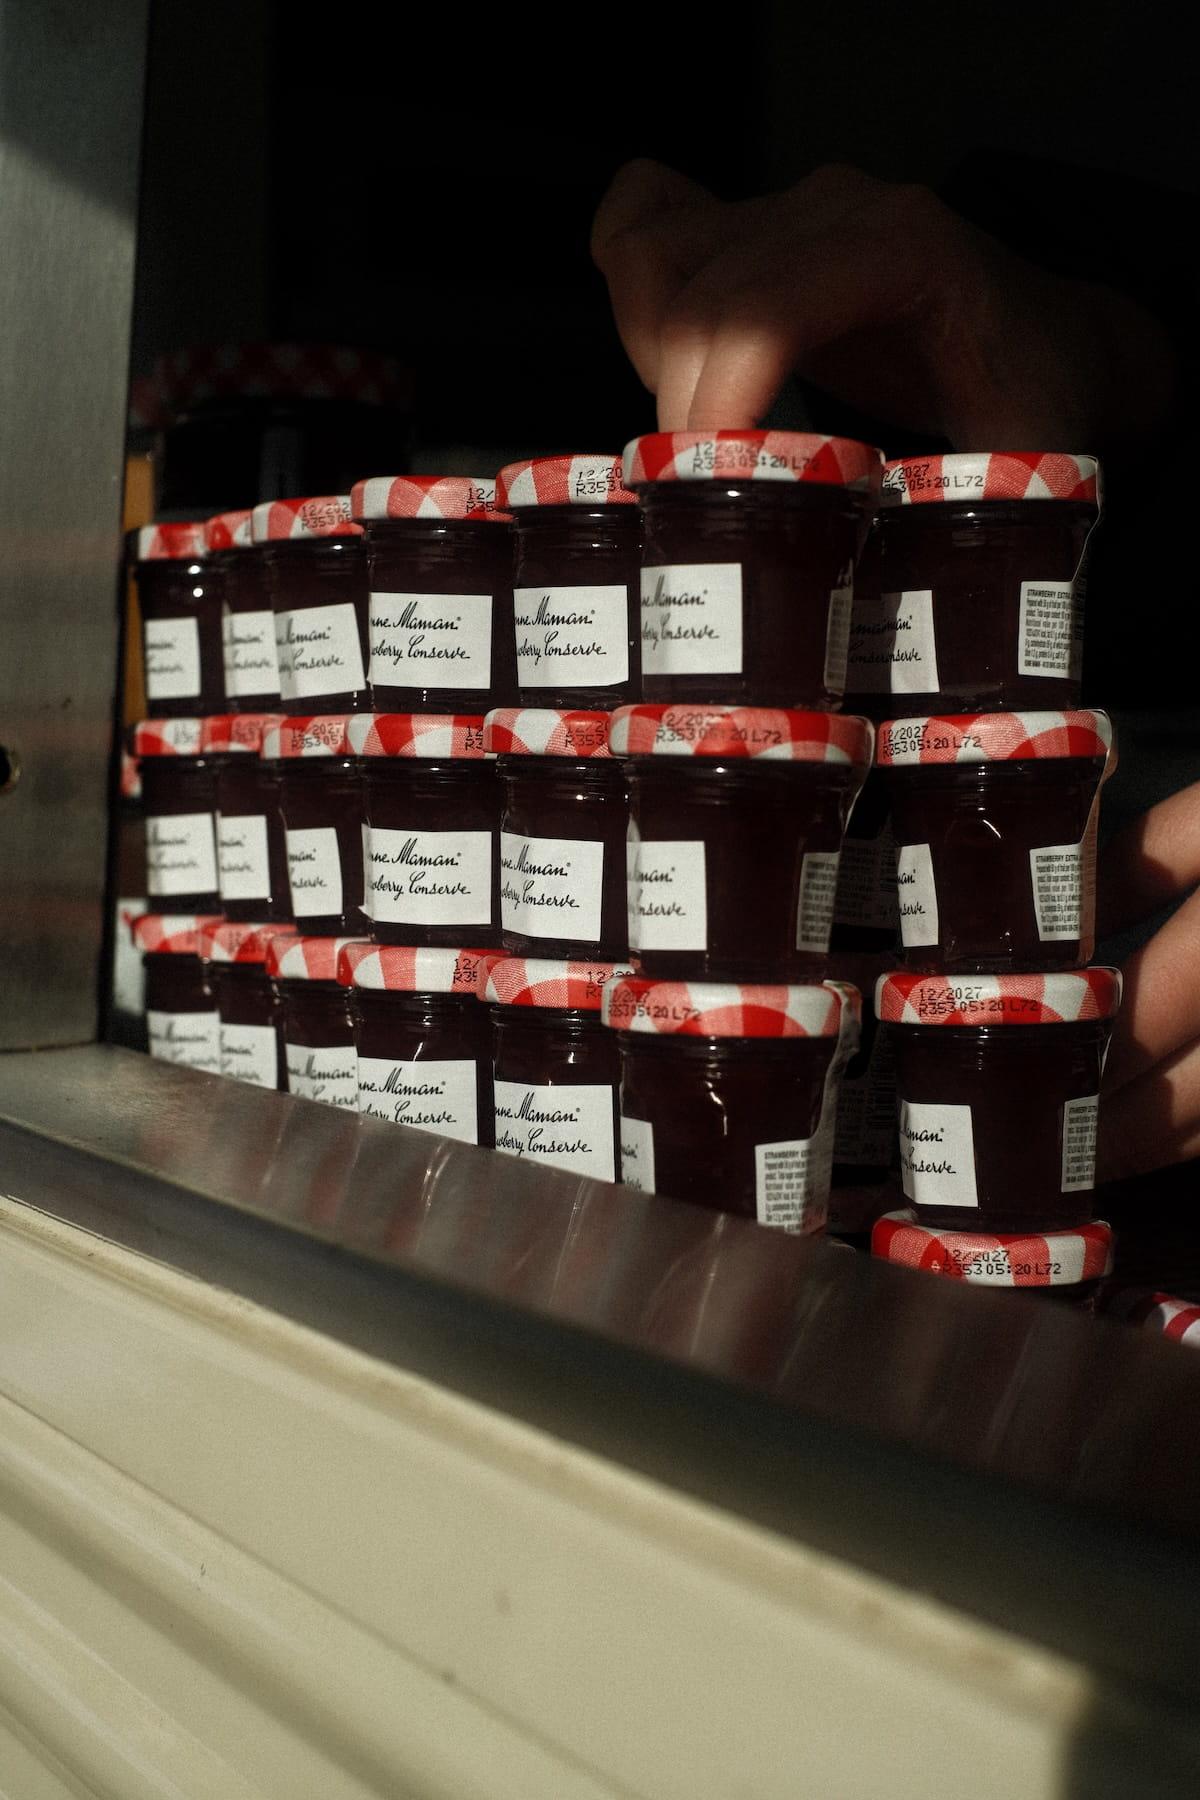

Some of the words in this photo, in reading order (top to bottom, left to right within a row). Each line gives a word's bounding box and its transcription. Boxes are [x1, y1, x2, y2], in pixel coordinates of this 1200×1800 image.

[955, 475, 984, 488] L72
[407, 633, 471, 660] Conserve
[544, 630, 607, 656] Conserve
[954, 736, 982, 749] L72
[409, 871, 471, 895] Conserve
[523, 880, 580, 908] Conserve
[918, 986, 983, 1002] 12/2027
[1009, 1000, 1039, 1013] L72
[394, 1100, 457, 1124] Conserve
[528, 1128, 592, 1153] Conserve
[1035, 1263, 1062, 1275] L72
